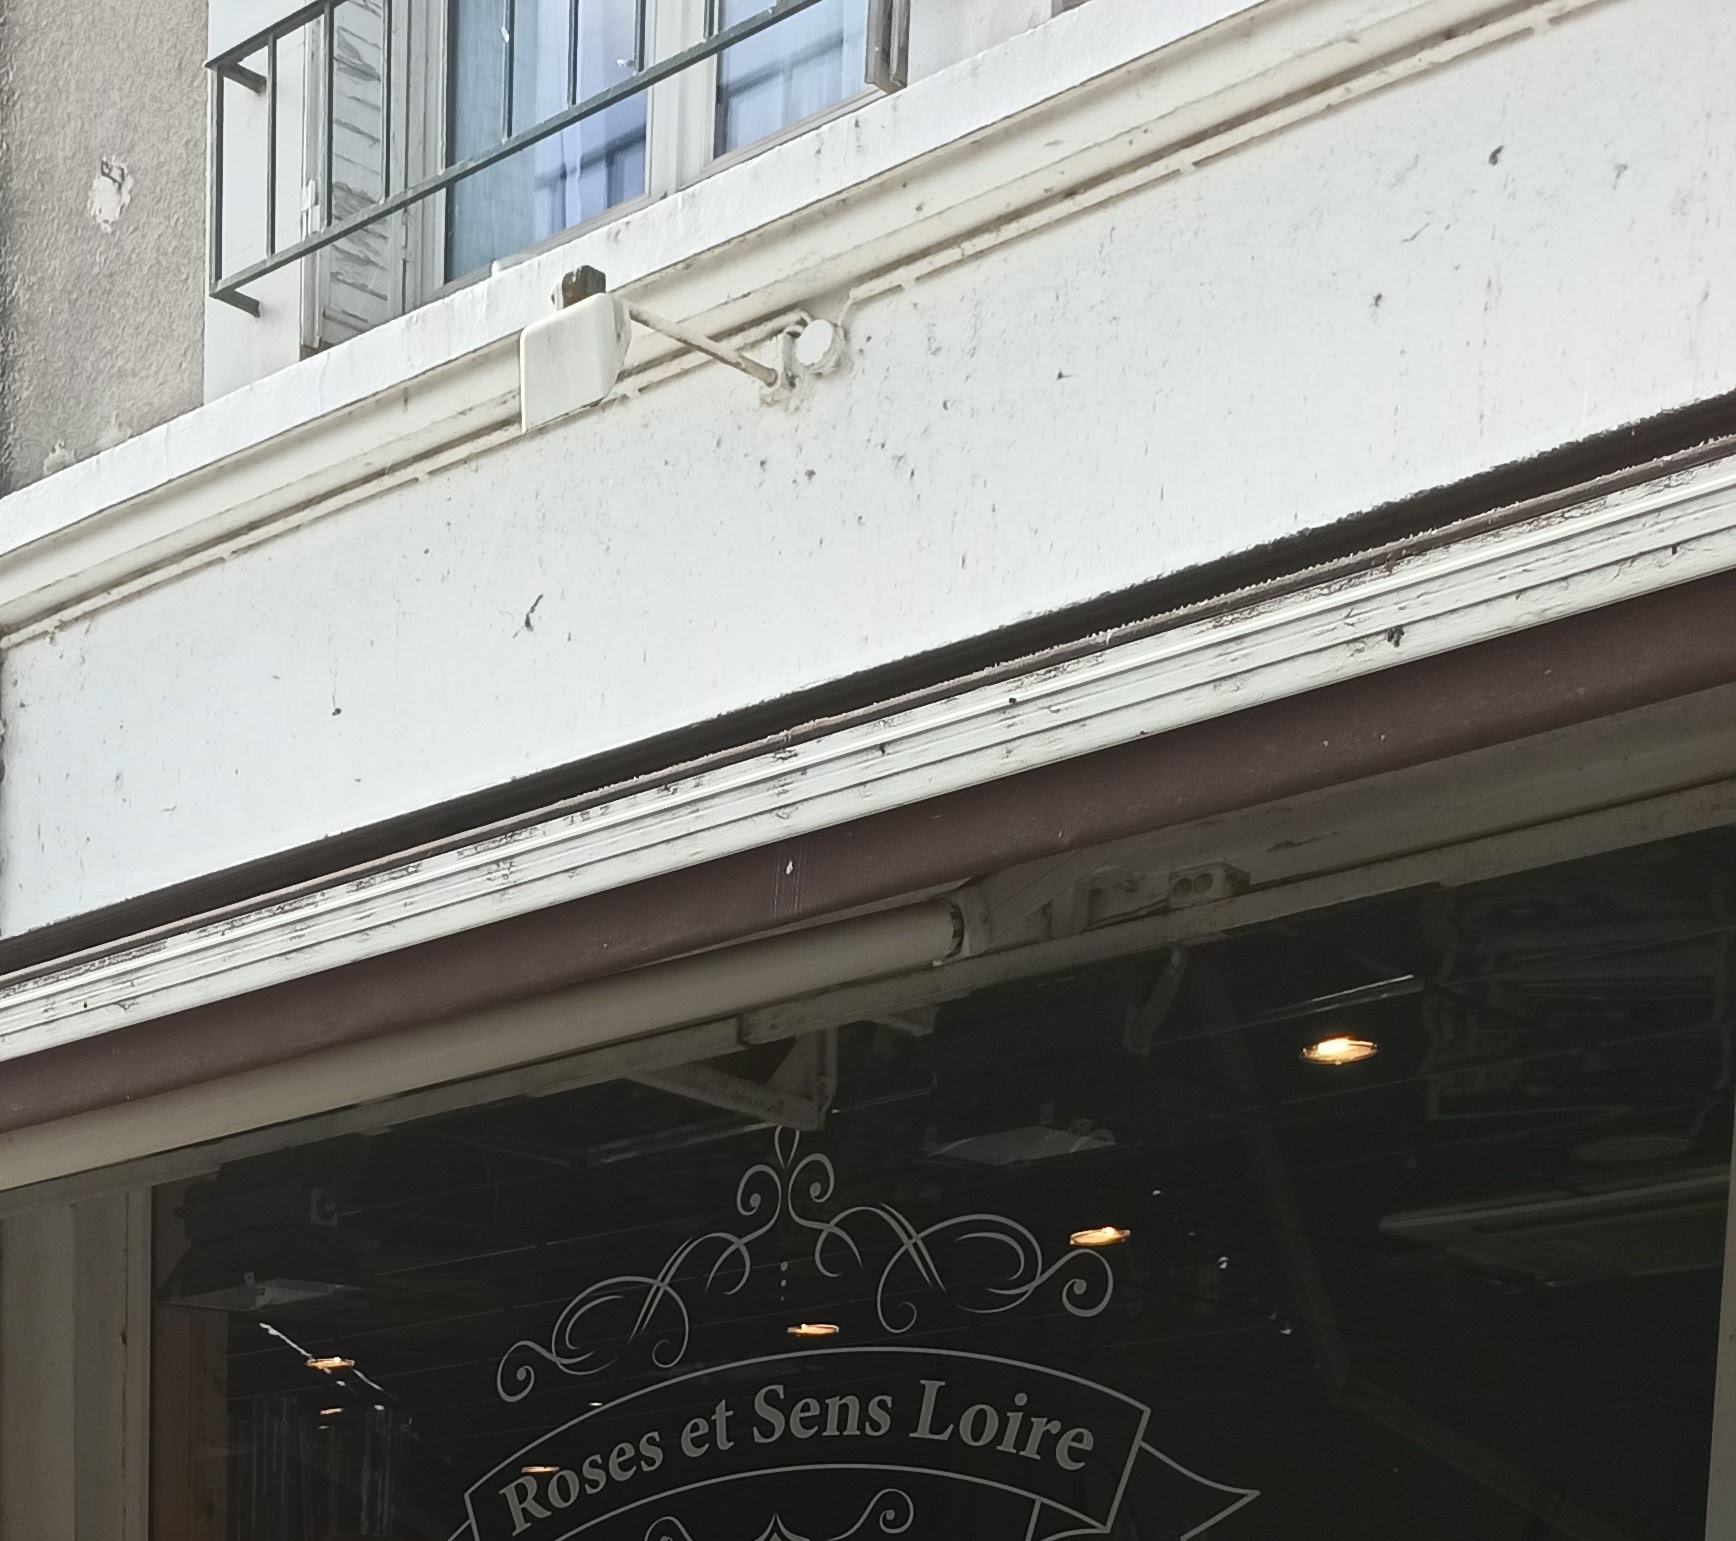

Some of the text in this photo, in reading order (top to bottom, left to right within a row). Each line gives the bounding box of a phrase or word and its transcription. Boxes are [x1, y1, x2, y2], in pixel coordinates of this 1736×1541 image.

[498, 1379, 1095, 1535] Roses et Sens Loire
